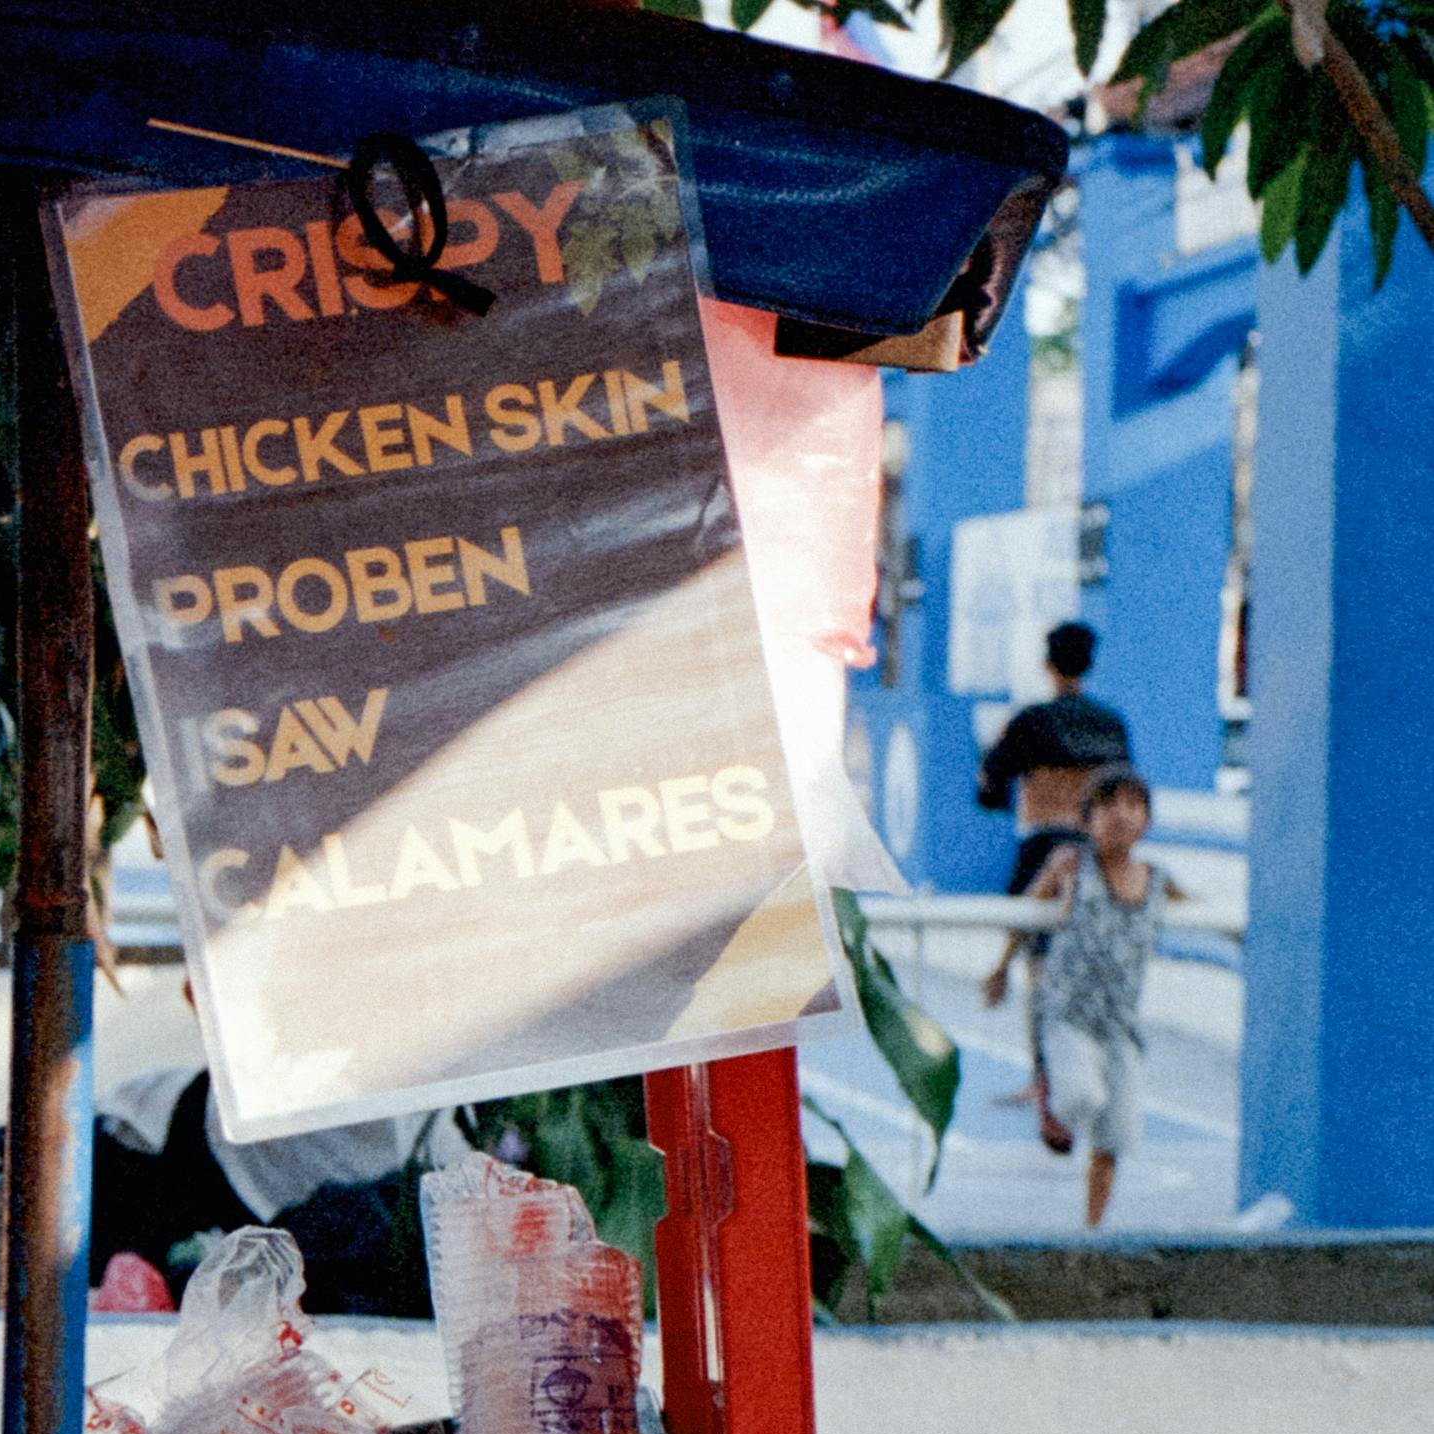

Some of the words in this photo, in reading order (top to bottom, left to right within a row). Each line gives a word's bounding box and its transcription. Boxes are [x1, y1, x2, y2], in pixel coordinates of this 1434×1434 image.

[118, 394, 473, 502] CHICKEN
[484, 360, 691, 452] SKIN
[150, 527, 531, 650] PROBEN
[198, 765, 776, 930] CALAMARES
